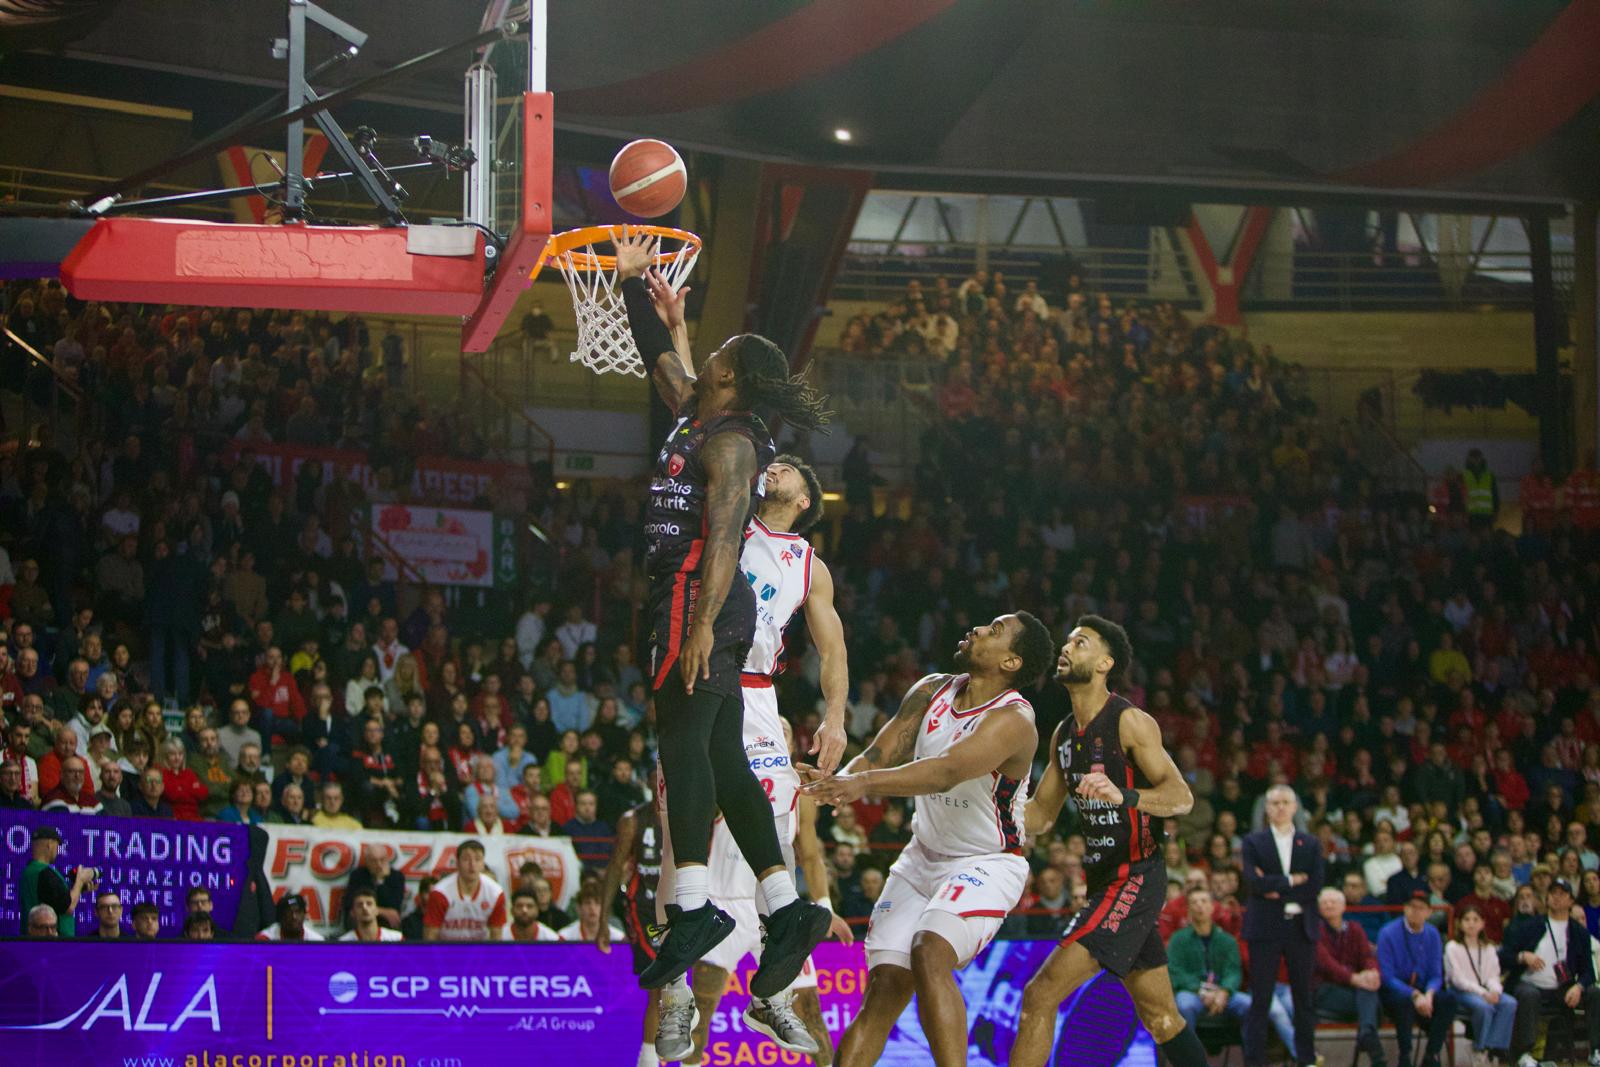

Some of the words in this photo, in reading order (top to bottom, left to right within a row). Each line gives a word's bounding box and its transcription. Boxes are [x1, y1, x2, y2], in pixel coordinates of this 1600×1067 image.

[83, 829, 231, 864] TRADING
[369, 976, 430, 998] SCP
[440, 975, 593, 998] SINTERSA
[81, 972, 221, 1032] ALA
[550, 1016, 596, 1032] Group
